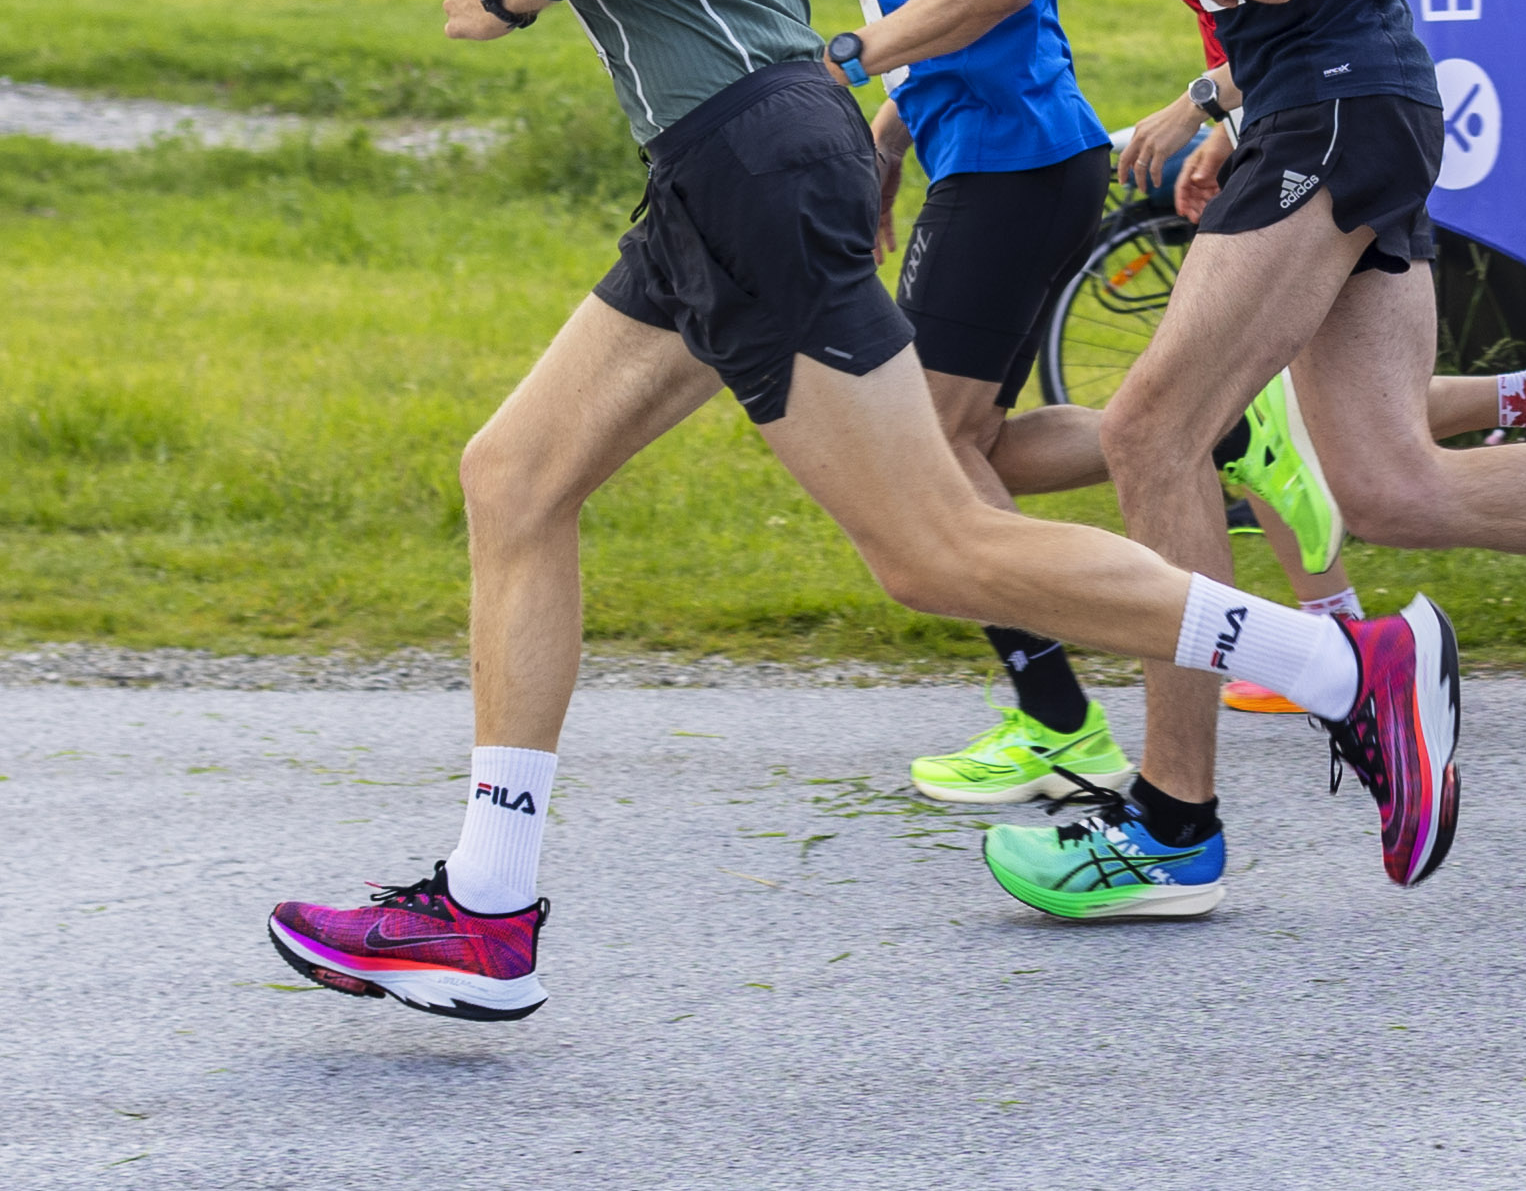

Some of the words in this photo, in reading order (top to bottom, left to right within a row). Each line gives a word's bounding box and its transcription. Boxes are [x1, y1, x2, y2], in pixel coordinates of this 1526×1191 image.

[1280, 174, 1320, 209] adidas
[1210, 605, 1248, 671] FILA
[475, 782, 536, 816] FILA
